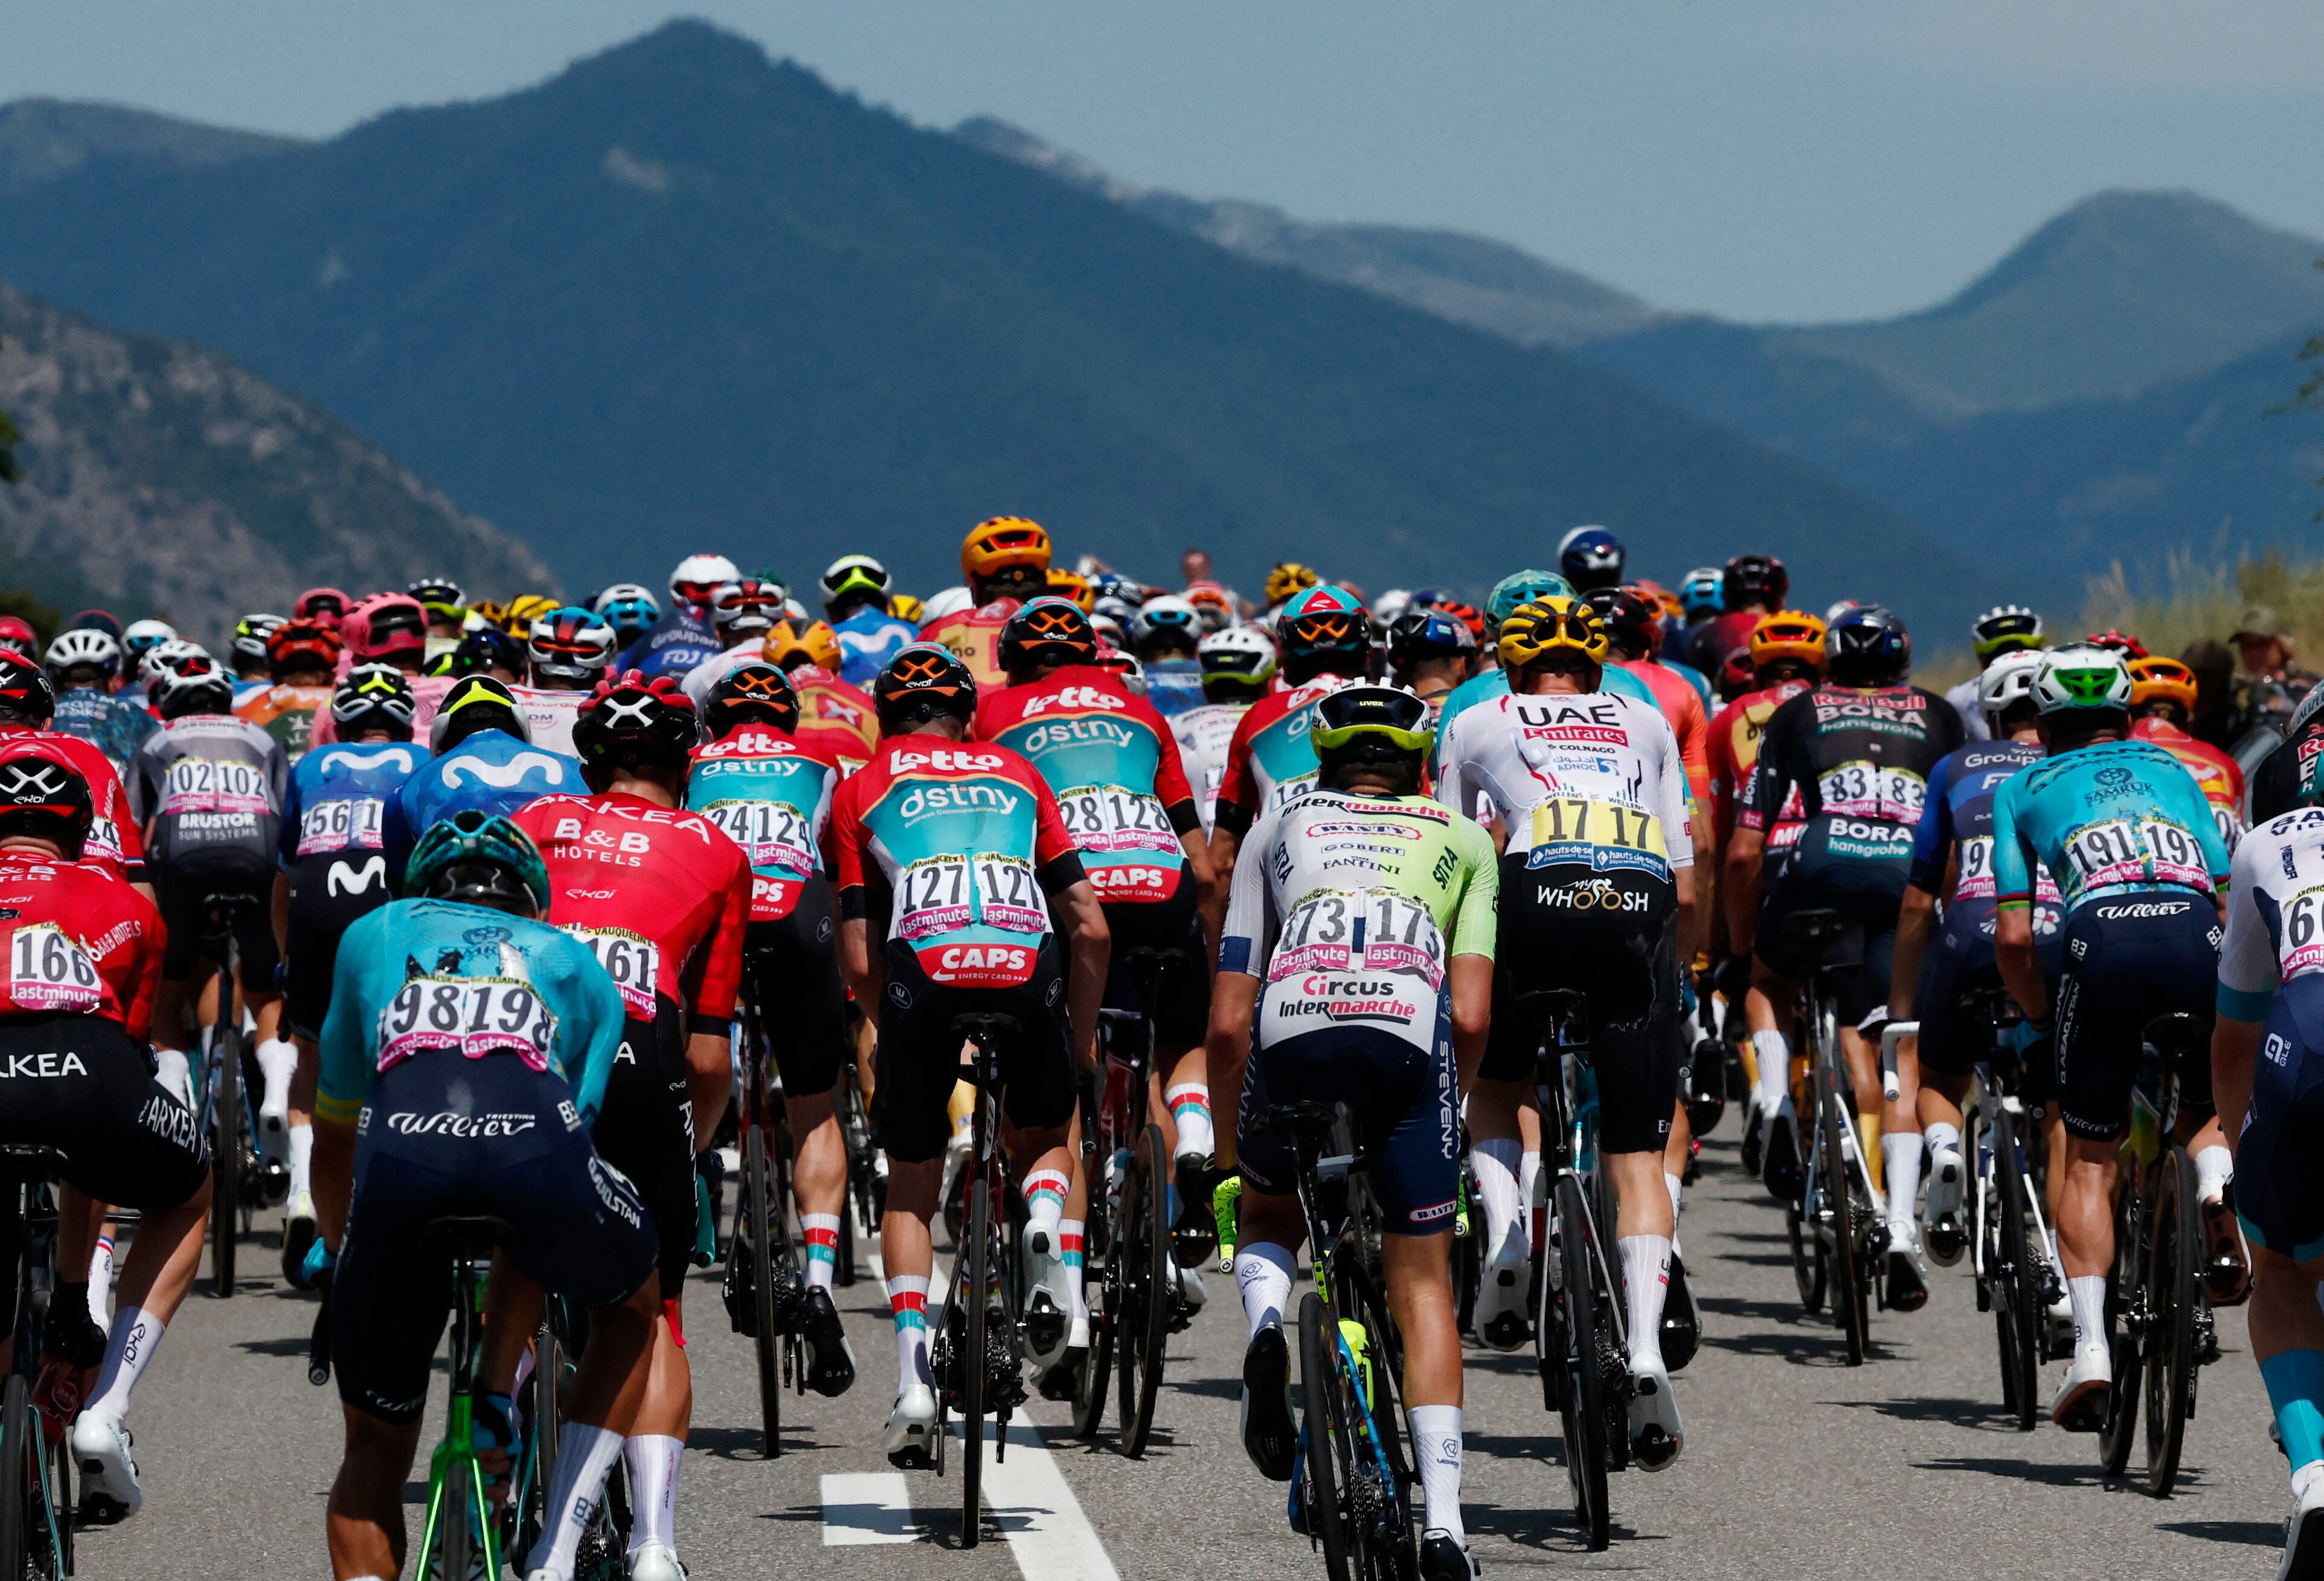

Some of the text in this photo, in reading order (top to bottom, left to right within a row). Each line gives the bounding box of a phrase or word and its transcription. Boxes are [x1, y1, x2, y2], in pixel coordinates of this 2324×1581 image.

[1518, 704, 1621, 726] UAE
[1817, 705, 1927, 730] BORA
[1026, 720, 1134, 753] dstny
[1529, 726, 1626, 745] Emirates
[1560, 745, 1616, 754] COLNAGO
[701, 760, 803, 777] dstny
[1544, 792, 1584, 800] WELLENS
[1831, 768, 1867, 803] 83
[900, 784, 1018, 818] dstny
[1109, 794, 1171, 832] 128
[178, 813, 257, 830] BRUSTOR
[301, 803, 349, 838] 156
[522, 795, 711, 845] ARKEA
[757, 806, 813, 855] 124
[1321, 824, 1407, 835] WANTY
[1546, 799, 1588, 842] 17
[1610, 806, 1652, 850] 17
[1829, 818, 1915, 844] BORA
[1113, 831, 1176, 847] lastminute
[1324, 844, 1403, 855] GOBERT
[1829, 839, 1909, 858] hansgrohe
[2072, 825, 2206, 875] 191 191
[0, 854, 114, 883] KEA
[554, 844, 642, 867] HOTELS
[754, 845, 814, 873] lastminute
[1324, 858, 1401, 876] FANTINI
[903, 864, 965, 916] 127
[1090, 868, 1163, 888] CAPS
[1537, 885, 1649, 912] WHOOSH
[900, 908, 1047, 935] lastminute lastminute
[1280, 897, 1346, 952] 173
[2288, 896, 2324, 948] 6
[594, 928, 646, 945] VAUQUELIN
[16, 932, 95, 987] 166
[941, 948, 1027, 970] CAPS
[11, 985, 101, 1006] lastminute
[1303, 975, 1395, 996] Circus
[468, 986, 551, 1051] 198
